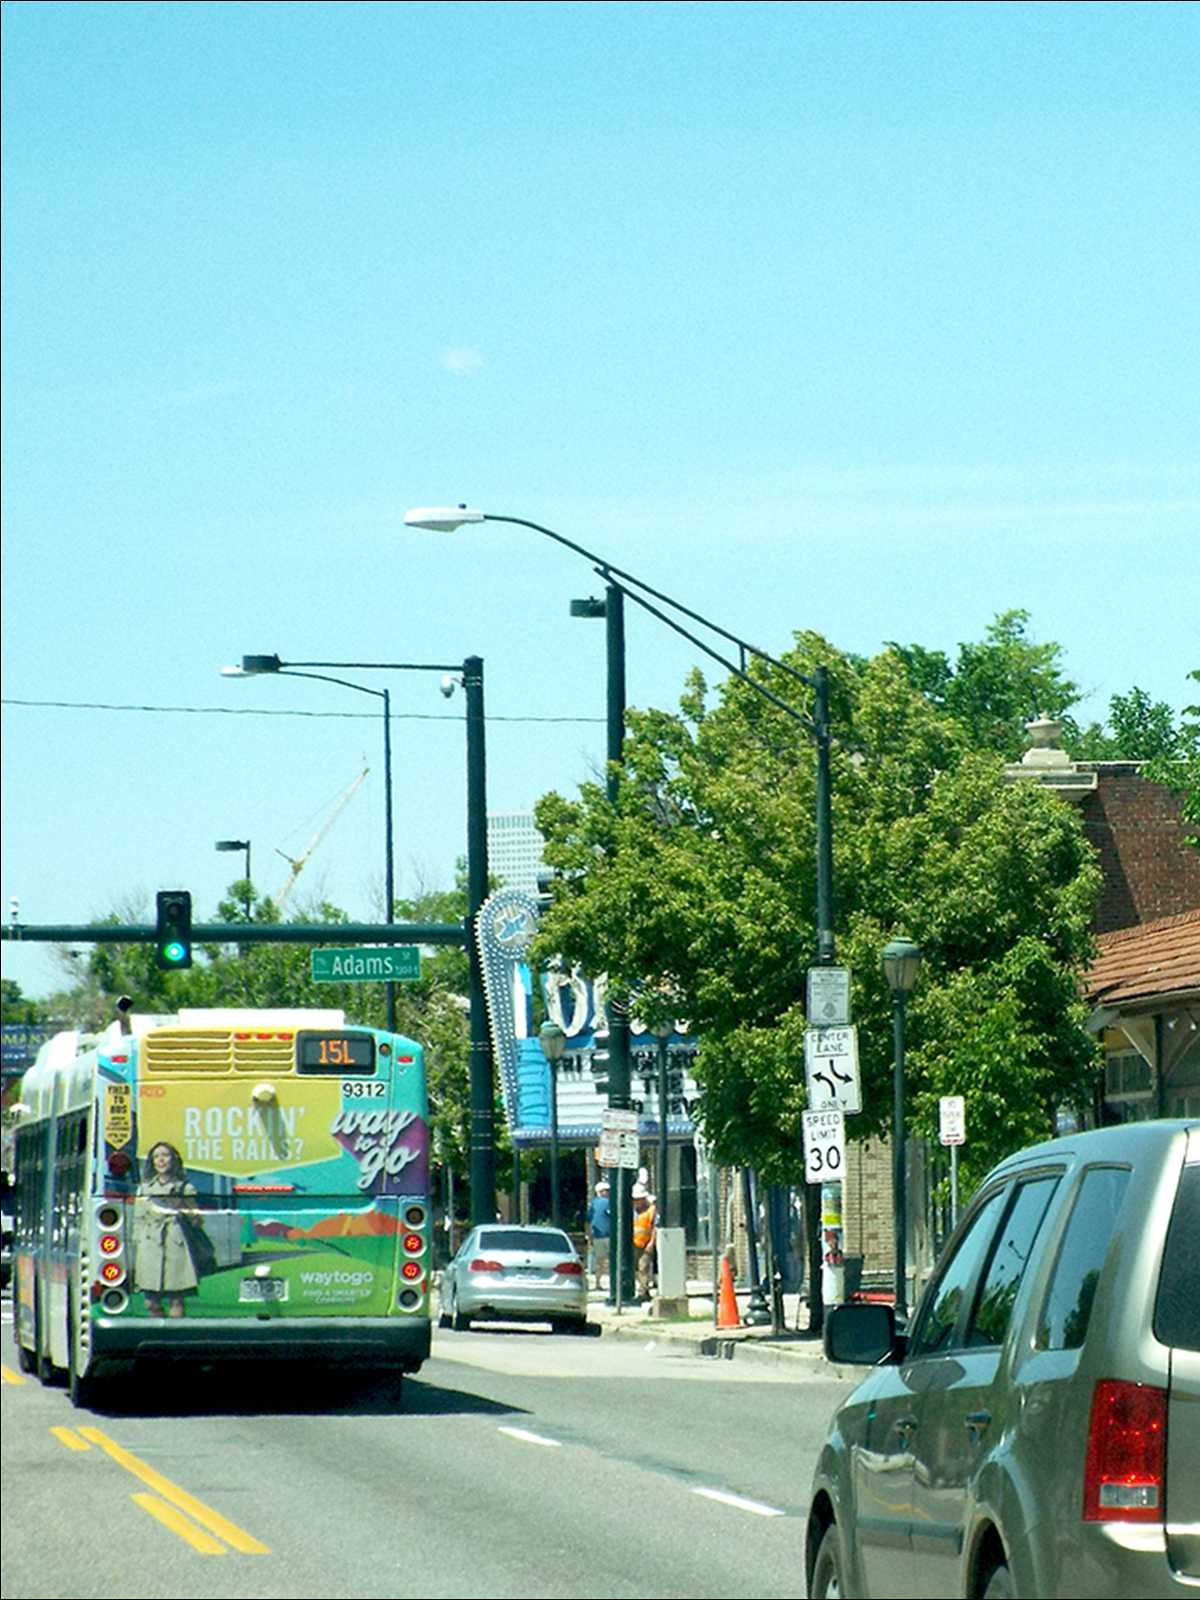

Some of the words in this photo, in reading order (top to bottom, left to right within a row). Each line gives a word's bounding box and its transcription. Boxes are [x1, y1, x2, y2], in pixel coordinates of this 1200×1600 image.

[332, 953, 394, 976] Adams
[811, 1032, 849, 1043] CENTER
[319, 1040, 355, 1064] 15L
[816, 1042, 844, 1053] LANE
[343, 1082, 385, 1098] 9312
[821, 1099, 848, 1109] ONLY
[184, 1106, 306, 1137] ROCKIN'
[330, 1110, 420, 1147] way
[806, 1114, 841, 1127] SPEED
[354, 1134, 377, 1151] to
[810, 1128, 837, 1142] LIMIT
[184, 1138, 224, 1160] THE
[232, 1138, 304, 1160] RAILS?
[810, 1145, 841, 1172] 30
[356, 1147, 420, 1189] go
[300, 1270, 374, 1286] waytogo
